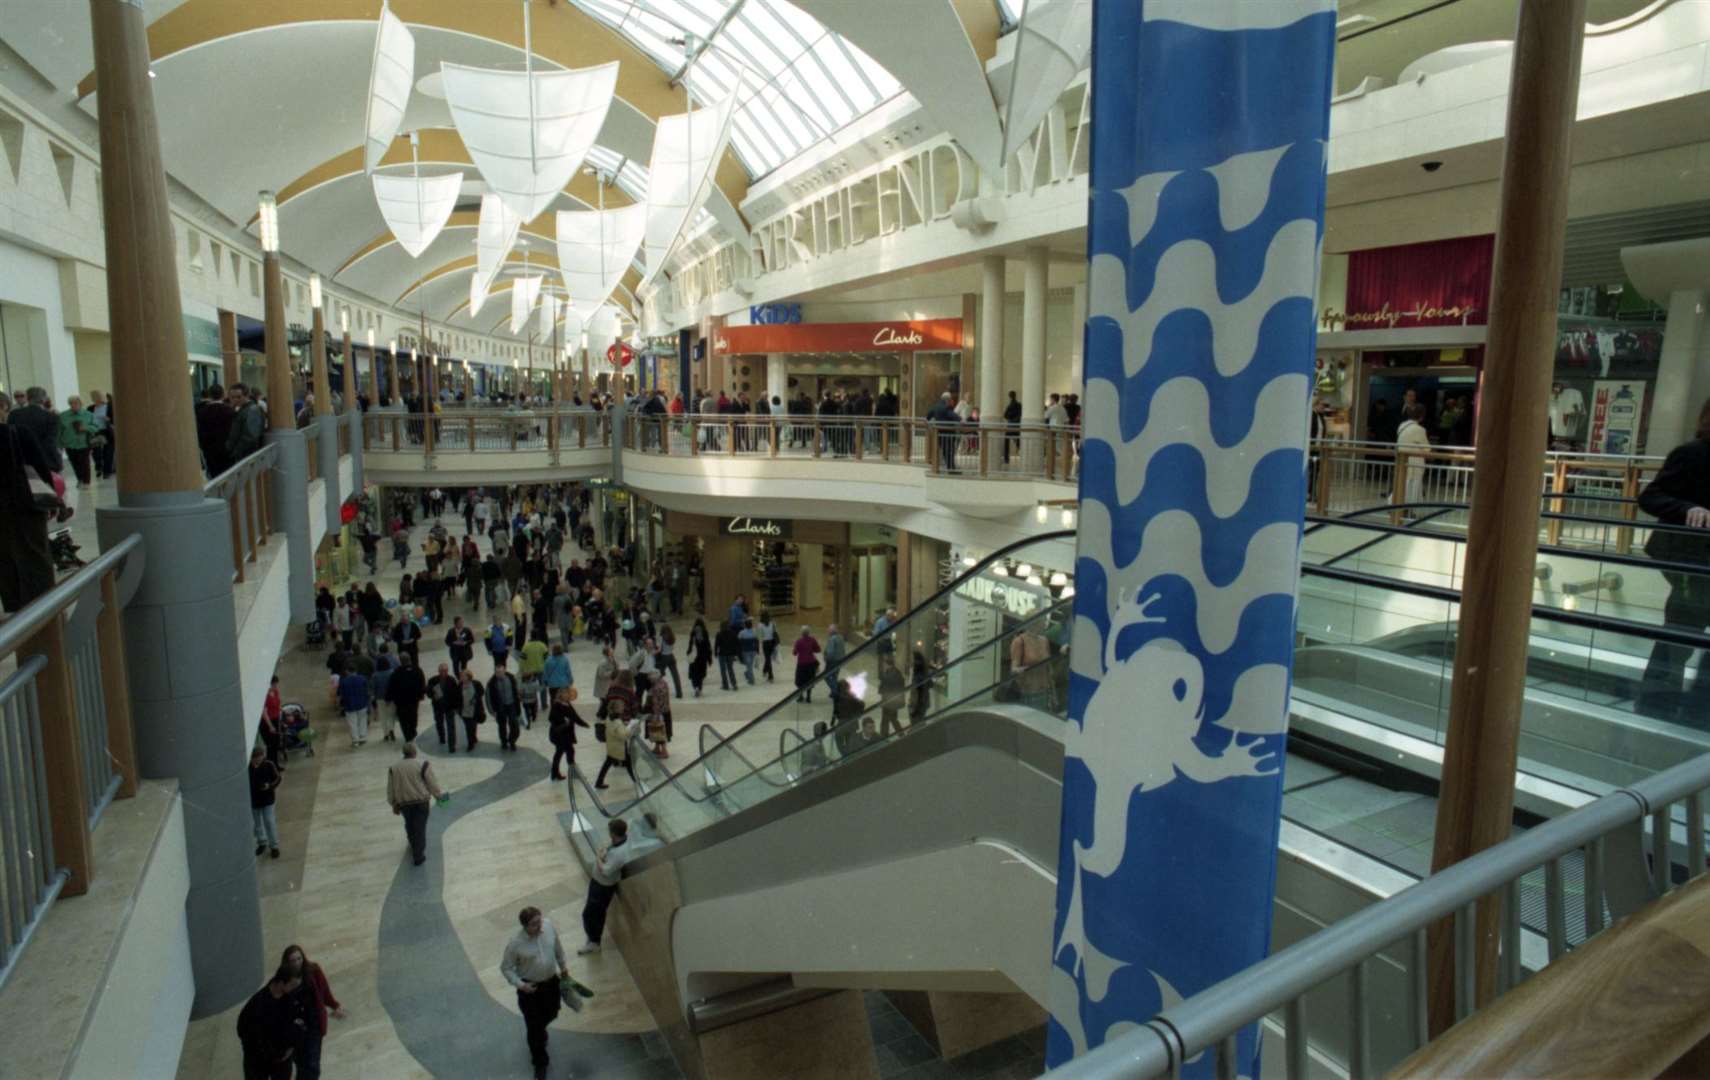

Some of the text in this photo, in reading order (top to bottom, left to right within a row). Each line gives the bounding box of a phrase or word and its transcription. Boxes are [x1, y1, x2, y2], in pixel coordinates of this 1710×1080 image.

[873, 327, 922, 345] Clarks
[1590, 386, 1608, 454] FREE
[728, 515, 781, 535] Clarks
